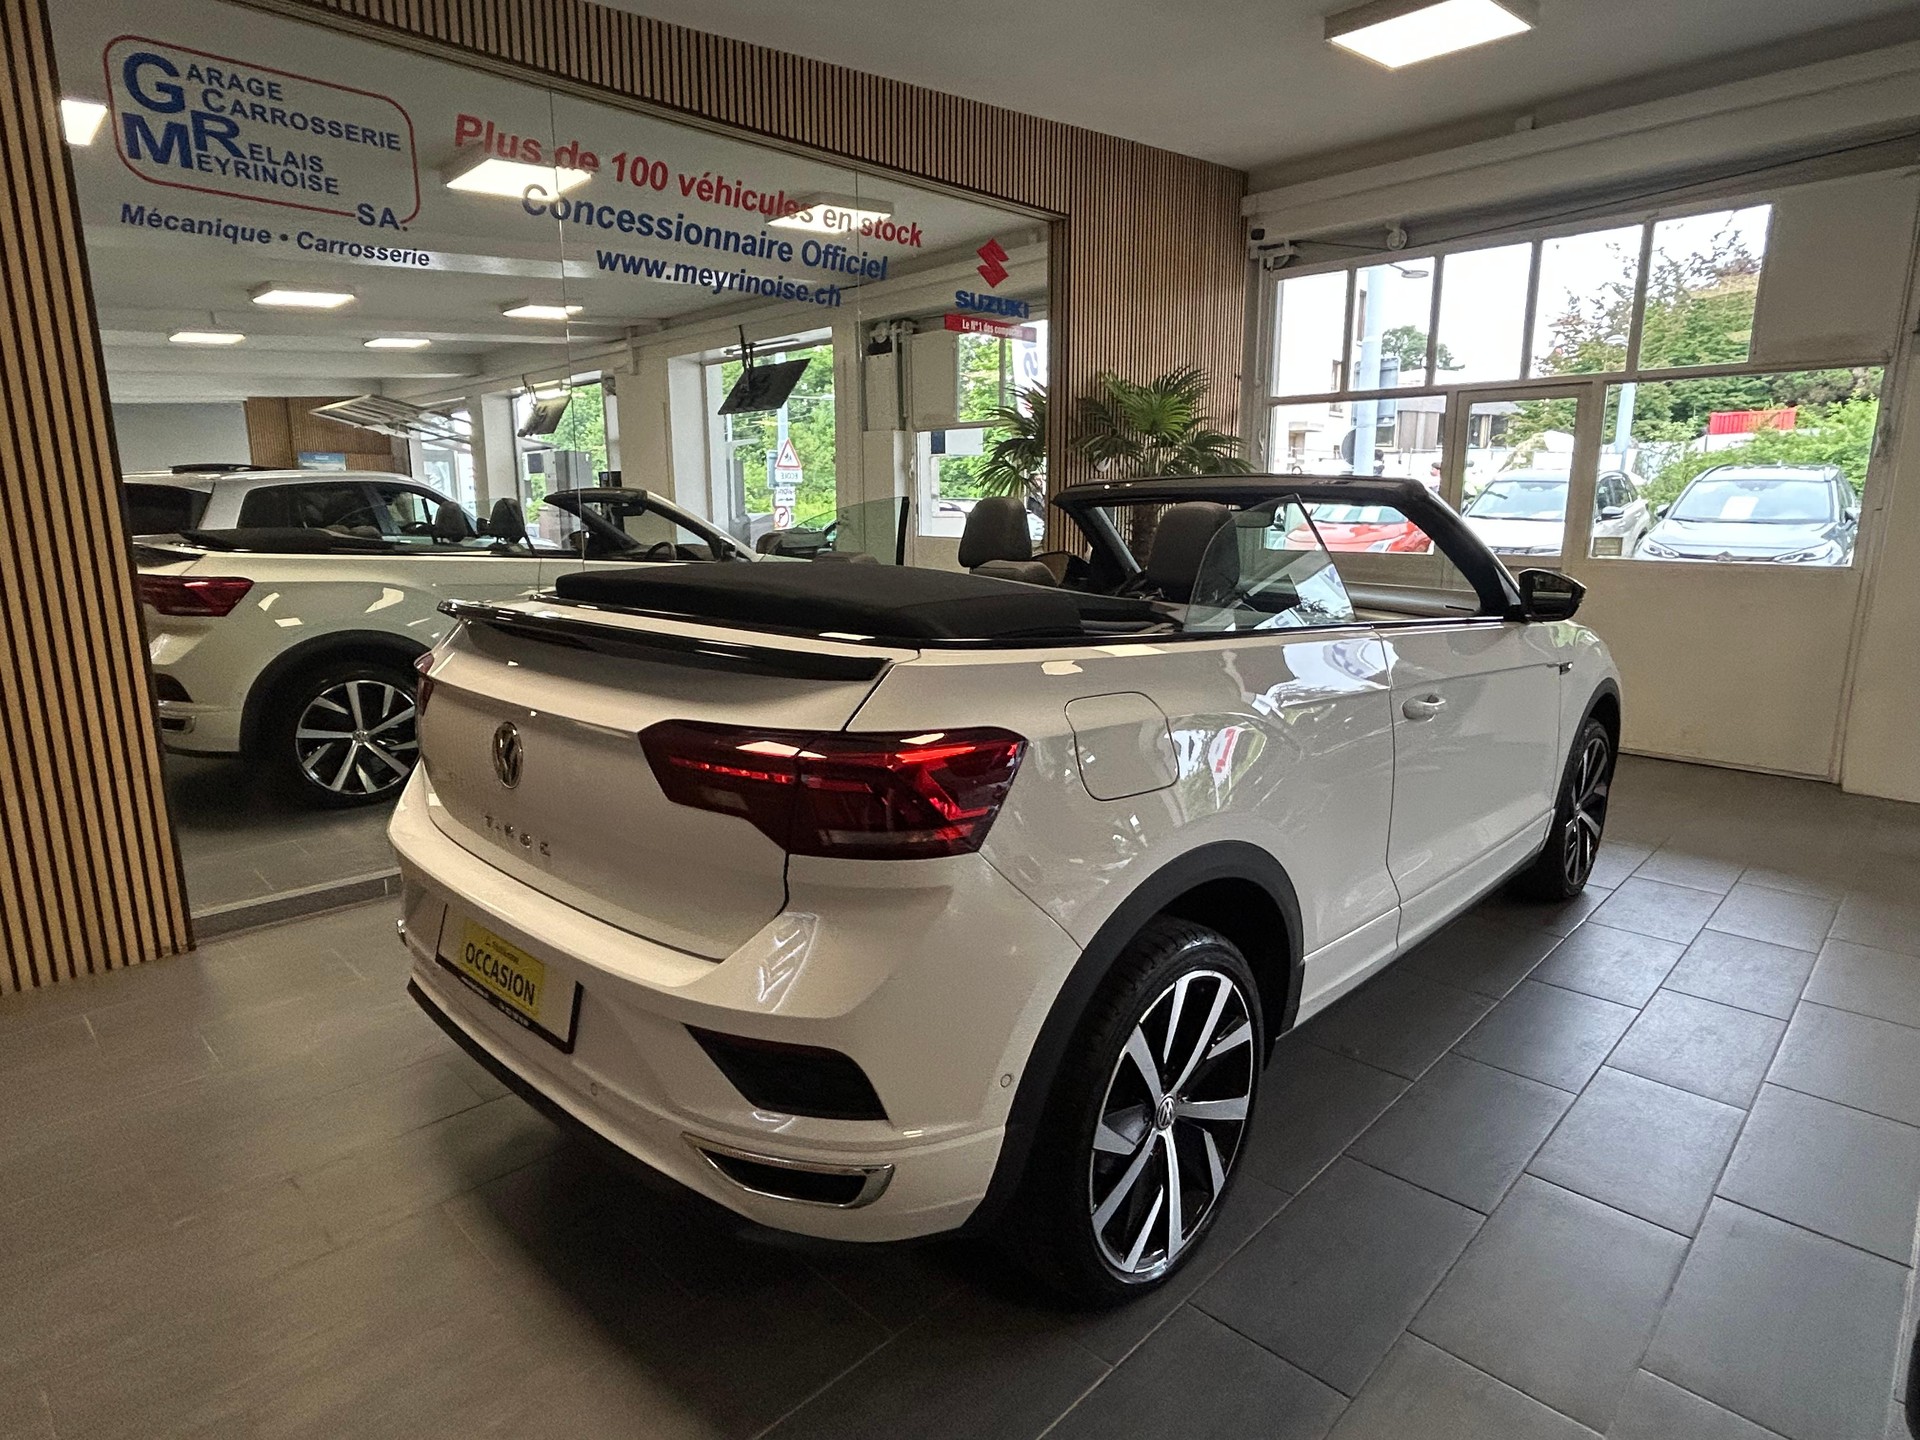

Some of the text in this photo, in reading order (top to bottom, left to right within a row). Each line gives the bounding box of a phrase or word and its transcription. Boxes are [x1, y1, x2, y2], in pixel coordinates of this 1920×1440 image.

[122, 52, 284, 113] GARAGE
[191, 110, 325, 173] RELAIS
[202, 87, 402, 152] CARROSSERIE
[121, 112, 340, 196] MEYRINOISE
[455, 114, 923, 249] Plus de 100 véhicules en stock
[121, 203, 431, 268] Mécanique Carrosserie
[522, 183, 889, 281] Concessionnaire Officiel
[596, 247, 842, 308] www.meyrinoise.ch
[955, 290, 1030, 320] SUZUKI
[465, 942, 536, 1007] OCCASION
